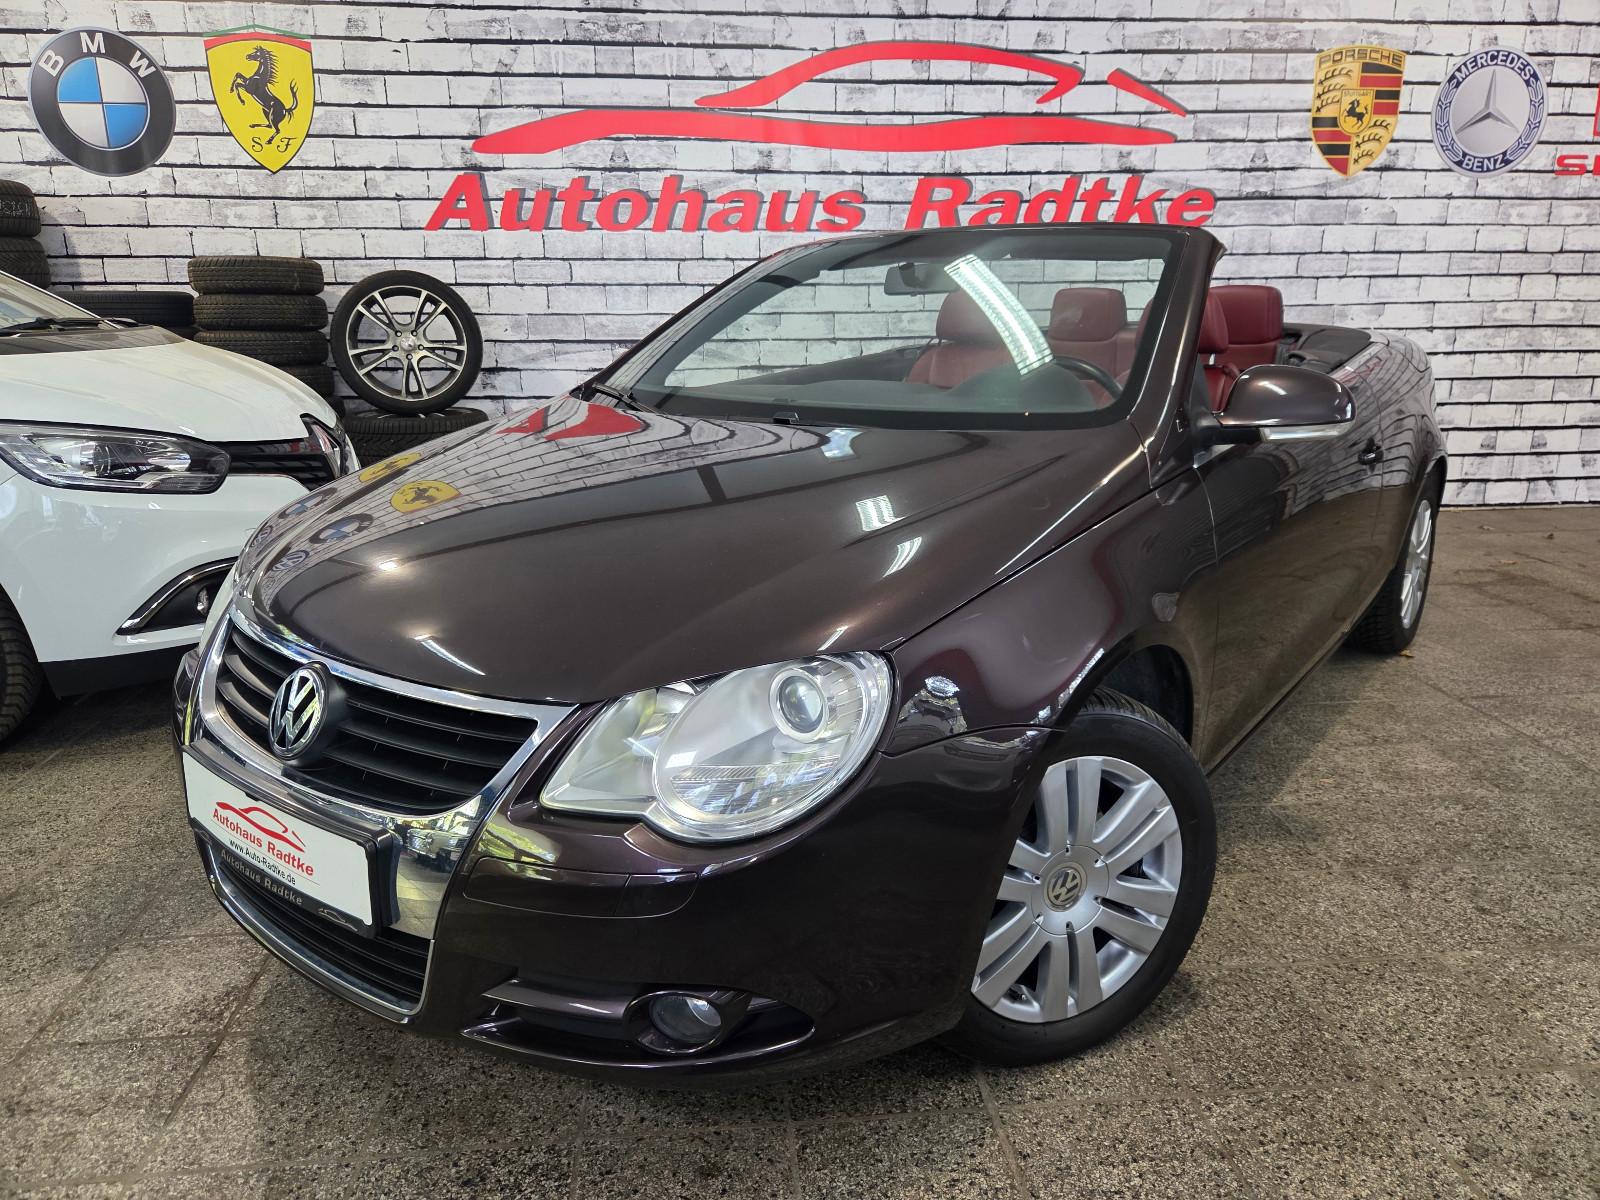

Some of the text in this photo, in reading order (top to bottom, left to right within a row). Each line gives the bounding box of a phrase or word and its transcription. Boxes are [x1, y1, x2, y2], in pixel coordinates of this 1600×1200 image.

[38, 32, 156, 78] BMW
[1319, 49, 1403, 69] PORSCHE
[1455, 51, 1534, 80] MERCEDES
[251, 137, 264, 153] S
[1462, 154, 1505, 171] BENZ
[424, 172, 1217, 232] Autohaus Radtke
[213, 808, 314, 876] Autohaus Radtke
[229, 839, 296, 885] www.Auto-Radtke.de
[221, 849, 302, 905] Autohaus Radtke
